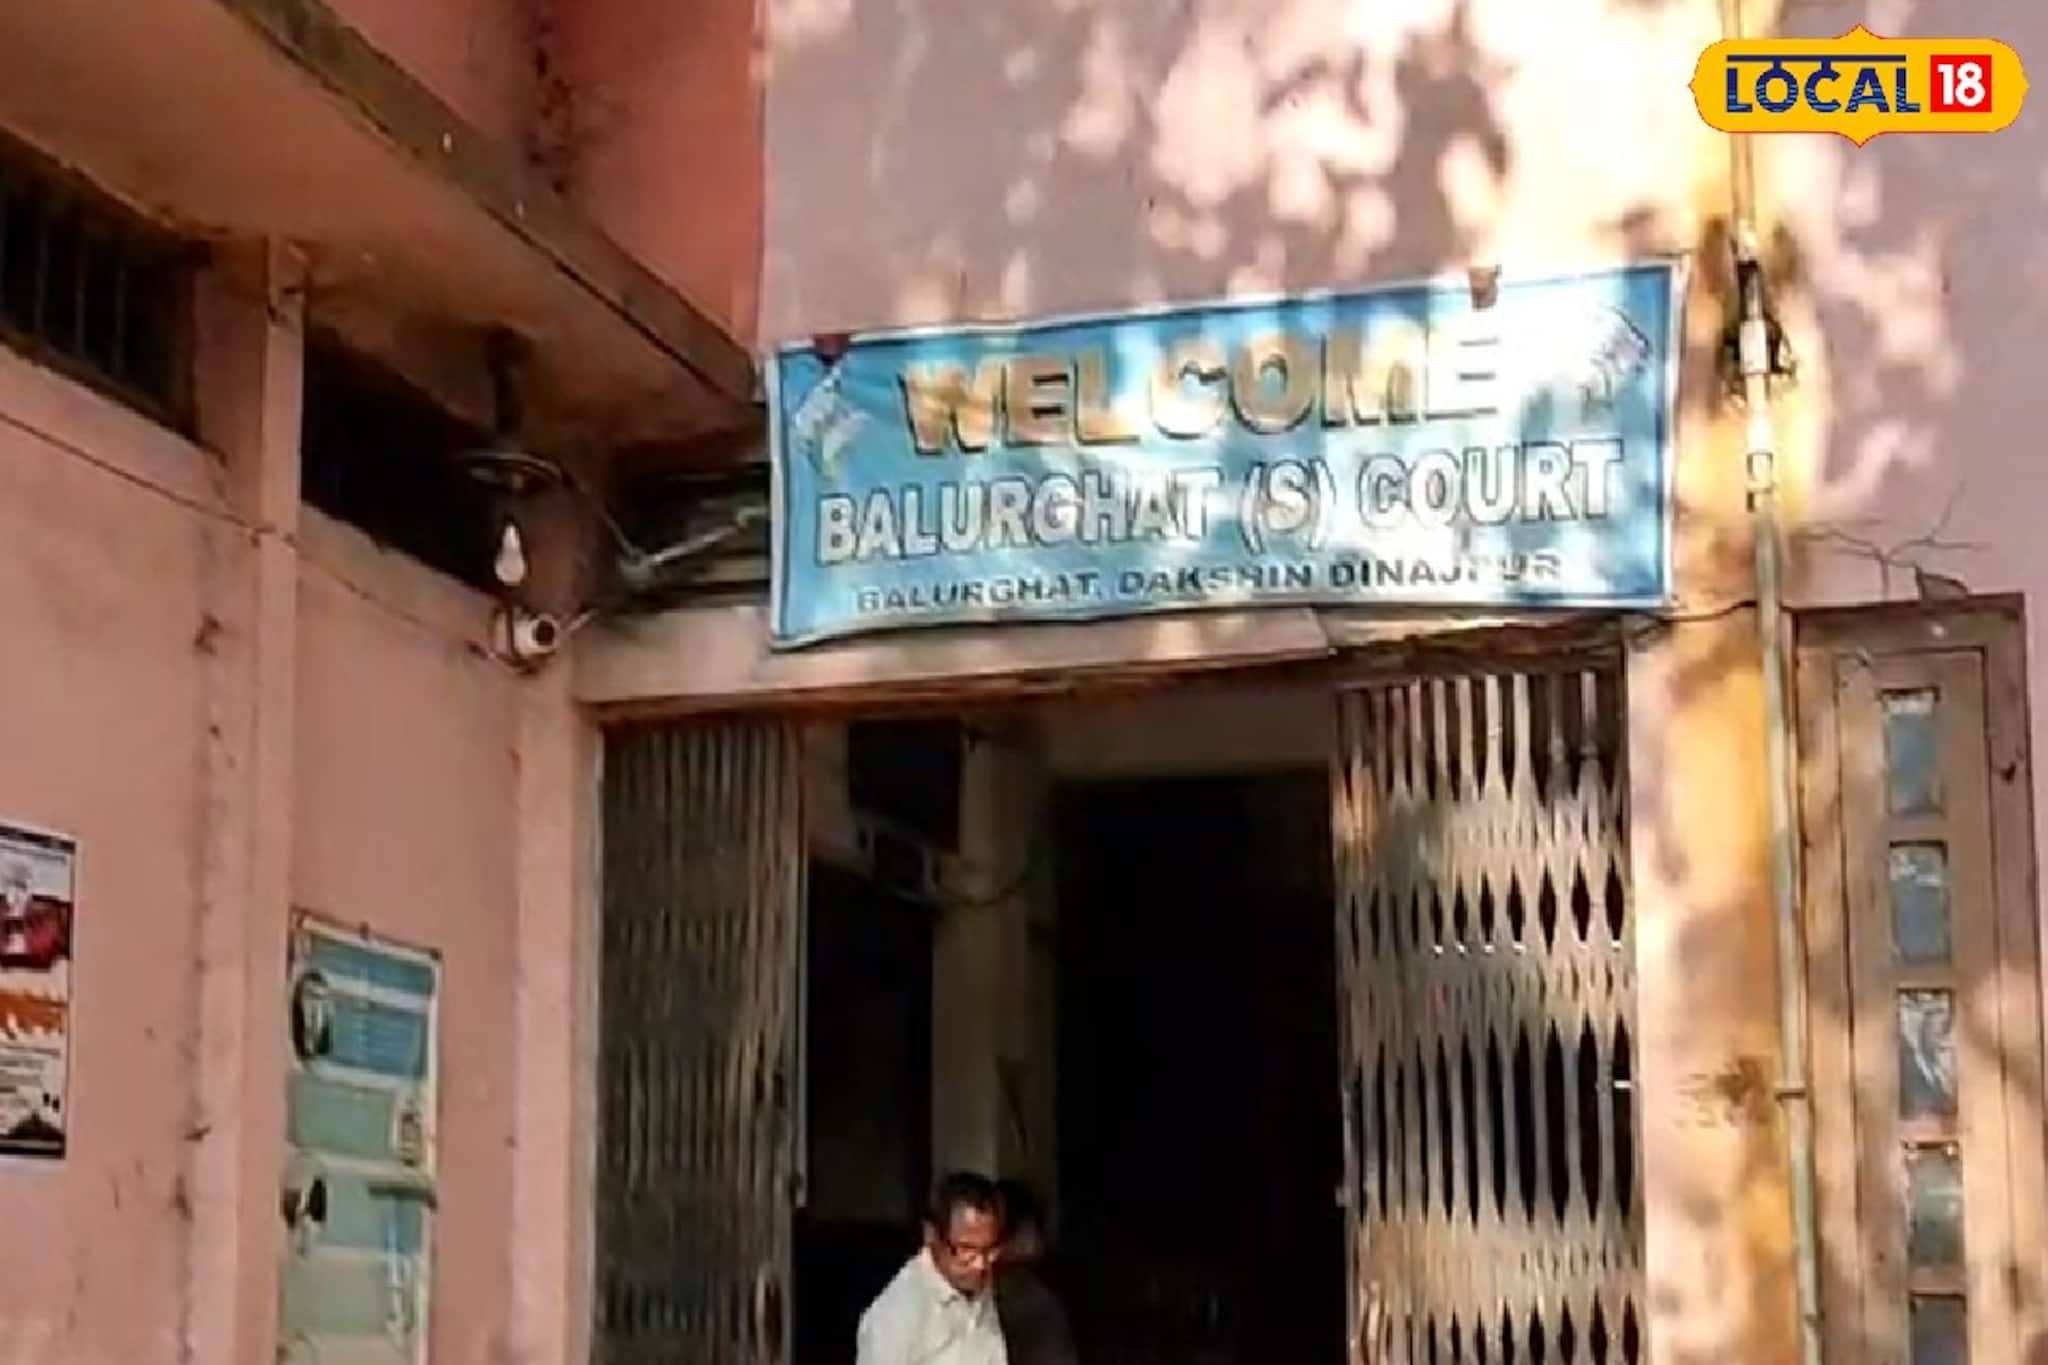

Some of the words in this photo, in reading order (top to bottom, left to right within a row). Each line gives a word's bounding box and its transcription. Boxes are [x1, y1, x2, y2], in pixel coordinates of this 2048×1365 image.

[899, 320, 1500, 456] WELCOME
[818, 465, 1219, 565] BALURGHAT
[1240, 461, 1335, 555] (S)
[1358, 440, 1624, 534] COURT
[1118, 562, 1313, 596] DAKSHIN
